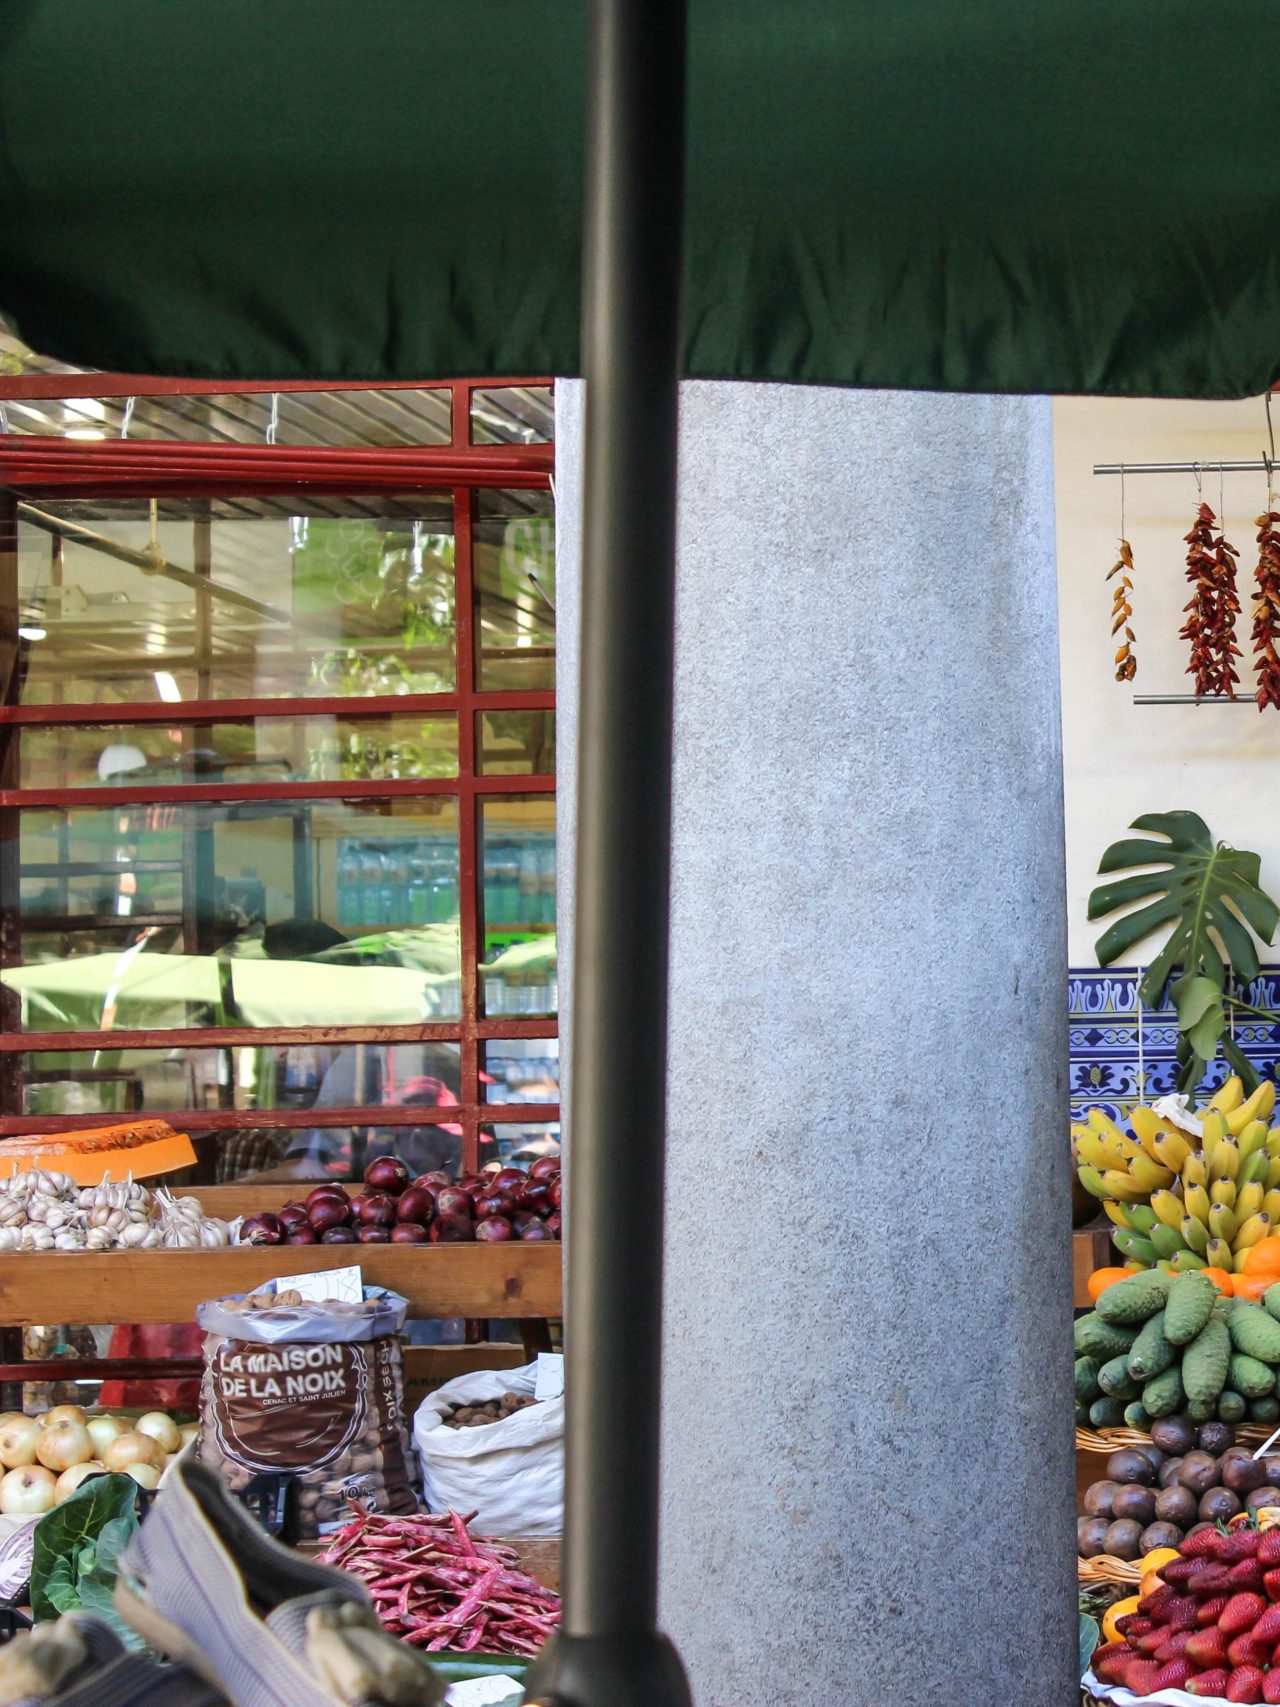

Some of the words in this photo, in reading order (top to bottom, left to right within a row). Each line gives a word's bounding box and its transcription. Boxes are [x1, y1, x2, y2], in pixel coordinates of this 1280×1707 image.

[220, 1352, 244, 1373] LA
[247, 1344, 343, 1374] MAISON
[221, 1376, 248, 1398] DE
[250, 1377, 282, 1398] LA
[286, 1368, 347, 1397] NOIX
[299, 1394, 320, 1402] SAINT
[321, 1389, 346, 1400] JULIEN
[336, 1486, 359, 1500] 10
